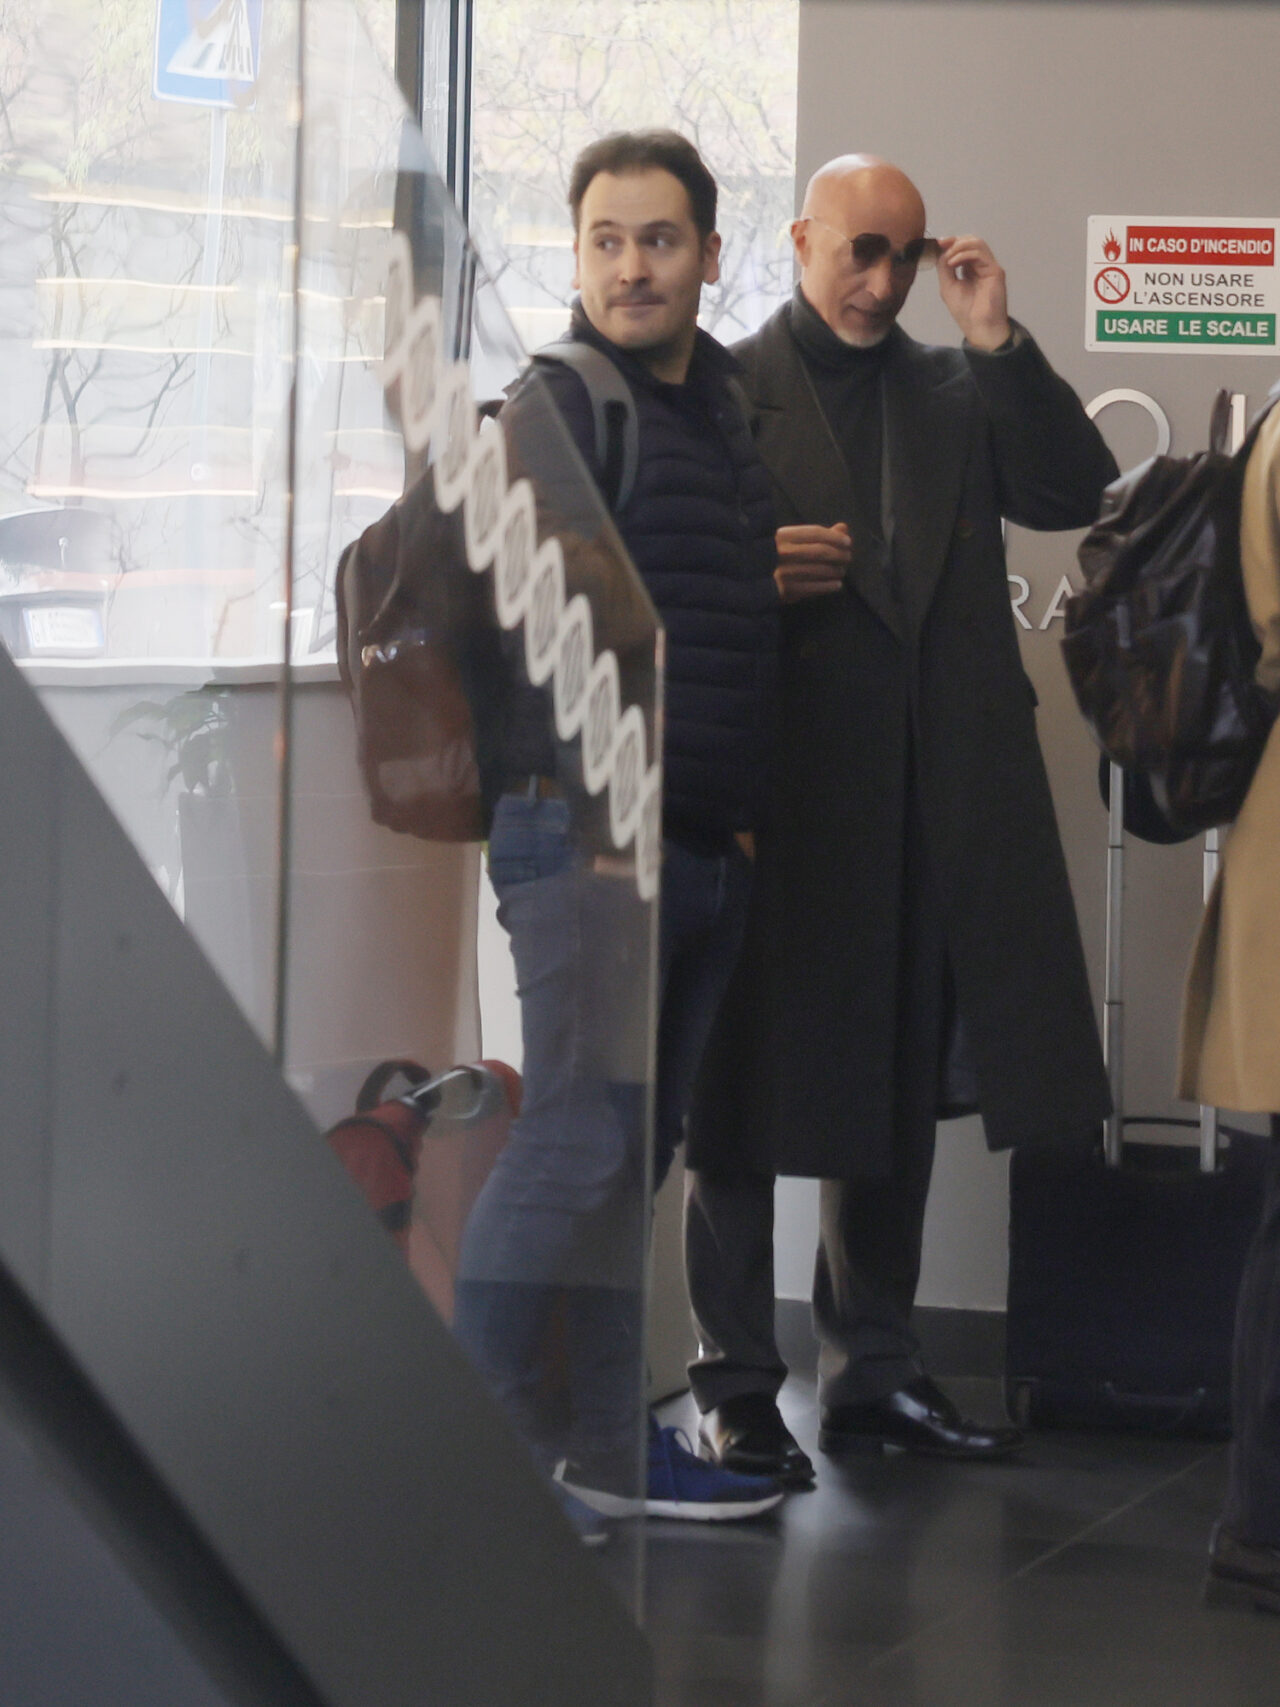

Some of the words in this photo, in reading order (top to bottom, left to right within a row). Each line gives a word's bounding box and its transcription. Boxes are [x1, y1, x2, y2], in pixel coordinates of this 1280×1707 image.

[1129, 238, 1144, 253] IN
[1147, 238, 1187, 253] CASO
[1190, 238, 1273, 254] D'INCENDIO
[1144, 272, 1184, 286] NON
[1191, 273, 1254, 287] USARE
[1133, 291, 1265, 307] L'ASCENSORE
[1104, 319, 1168, 335] USARE
[1178, 320, 1201, 336] LE
[1206, 321, 1269, 337] SCALE
